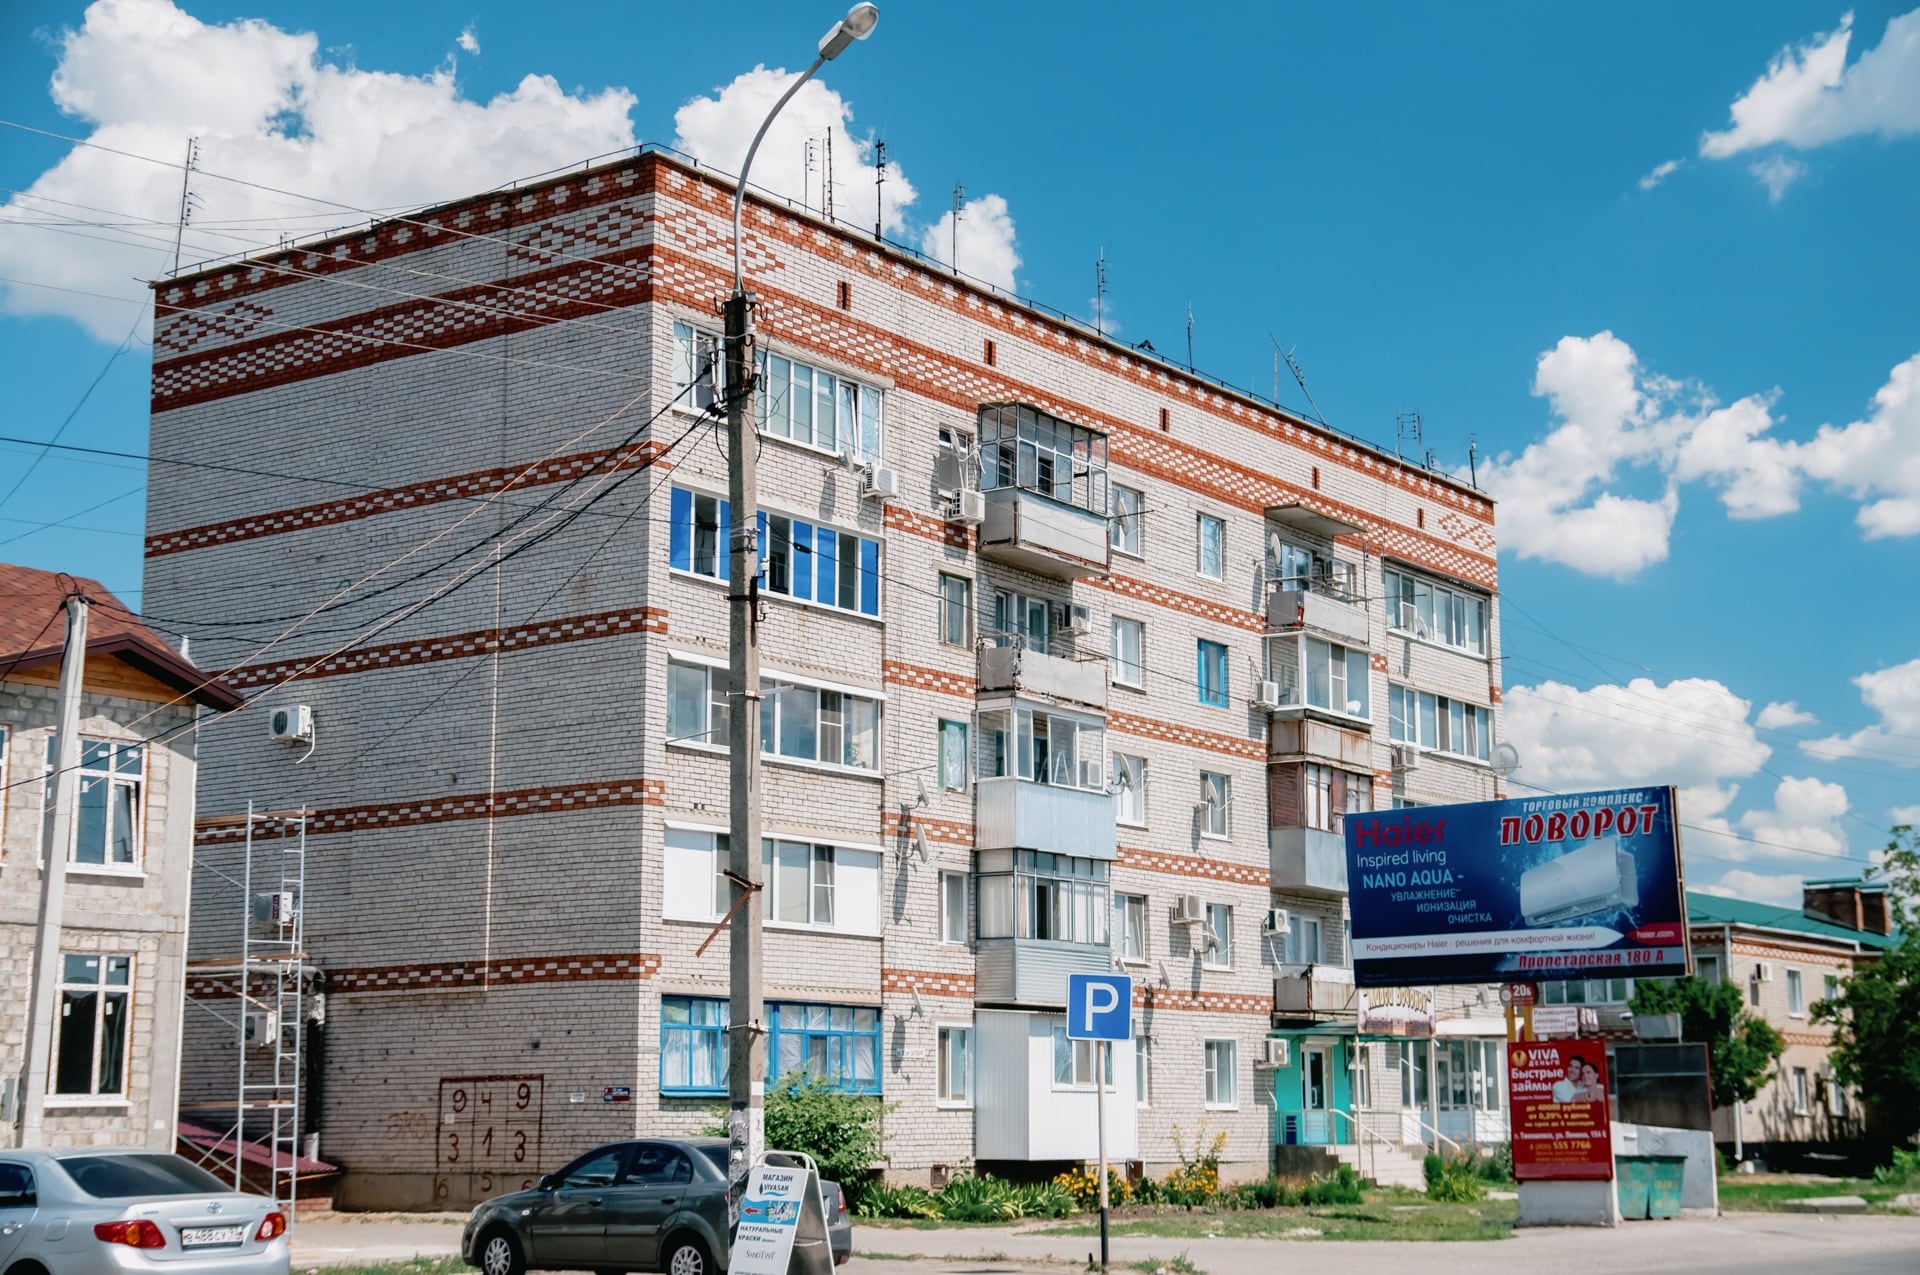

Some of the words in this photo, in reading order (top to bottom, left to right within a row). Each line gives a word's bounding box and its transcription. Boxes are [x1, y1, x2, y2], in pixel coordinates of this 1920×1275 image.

[1523, 796, 1579, 812] ТОРГОВЫЙ
[1582, 792, 1643, 808] КОМПЛЕКС
[1356, 815, 1446, 848] Haier
[1501, 804, 1658, 845] ПОВОРОТ
[1357, 850, 1408, 869] Inspired
[1412, 849, 1446, 866] living
[1363, 871, 1406, 889] NANO
[1410, 868, 1454, 886] AQUA
[1391, 888, 1458, 902] УВЛАЖНЕНИЕ
[1416, 899, 1476, 913] ИОНИЗАЦИЯ
[1447, 912, 1492, 924] ОЧИСТКА
[1366, 941, 1425, 952] Кондиционеры
[1427, 938, 1448, 949] Haier
[1455, 937, 1492, 948] решения
[1494, 936, 1509, 946] для
[1511, 933, 1564, 946] комфортной
[1636, 930, 1675, 940] haier.com
[1519, 953, 1621, 969] Пролетарская
[1626, 949, 1650, 964] 180
[1085, 982, 1119, 1032] P
[1527, 1048, 1560, 1060] VIVA
[1512, 1068, 1564, 1080] Быстрые
[1512, 1080, 1552, 1092] займы
[452, 1089, 467, 1113] 9
[481, 1090, 492, 1115] 4
[516, 1083, 531, 1109] 9
[447, 1133, 459, 1163] 3
[482, 1126, 493, 1157] 1
[514, 1130, 527, 1163] 3
[762, 1174, 793, 1182] МАГАЗИН
[764, 1184, 790, 1192] VIVASAN
[740, 1225, 784, 1234] НАТУРАЛЬНЫЕ
